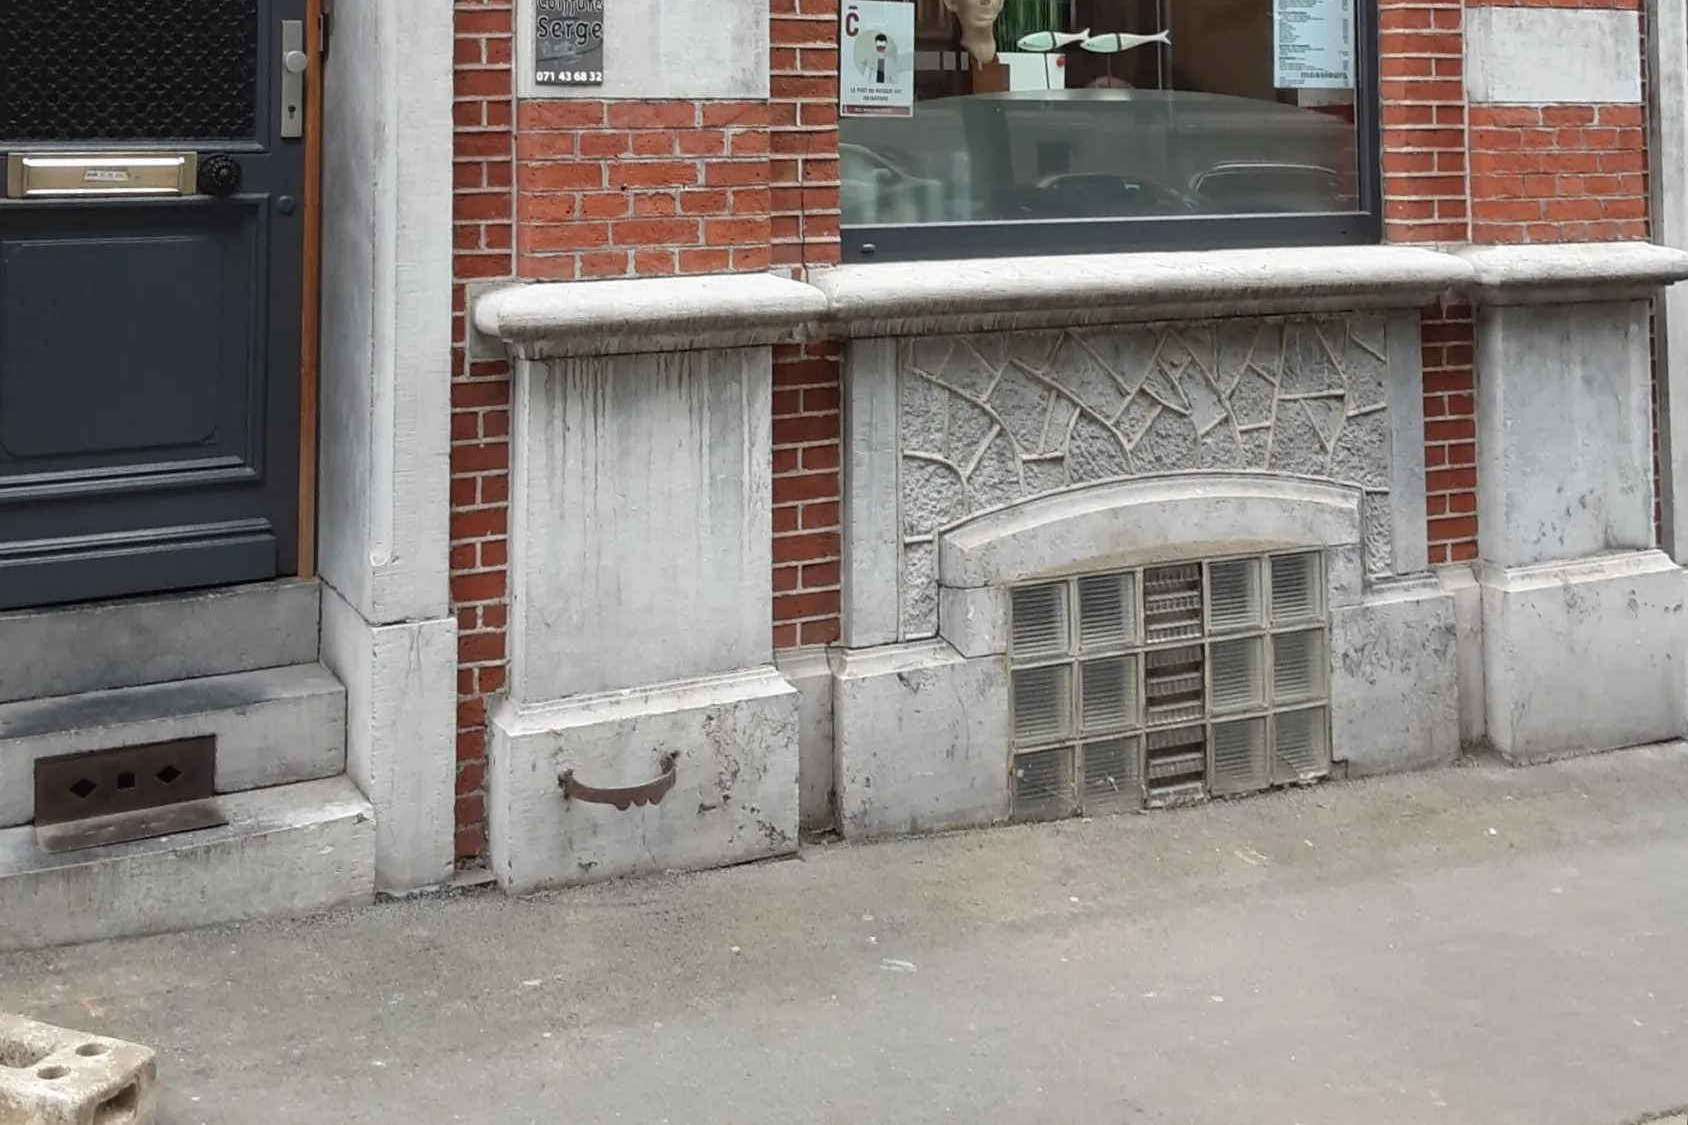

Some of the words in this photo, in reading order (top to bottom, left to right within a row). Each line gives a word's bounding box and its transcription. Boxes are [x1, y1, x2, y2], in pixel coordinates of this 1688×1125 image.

[537, 15, 603, 48] Serge
[536, 71, 555, 81] 071
[558, 71, 572, 81] 43
[573, 71, 587, 81] 68
[589, 71, 602, 82] 32
